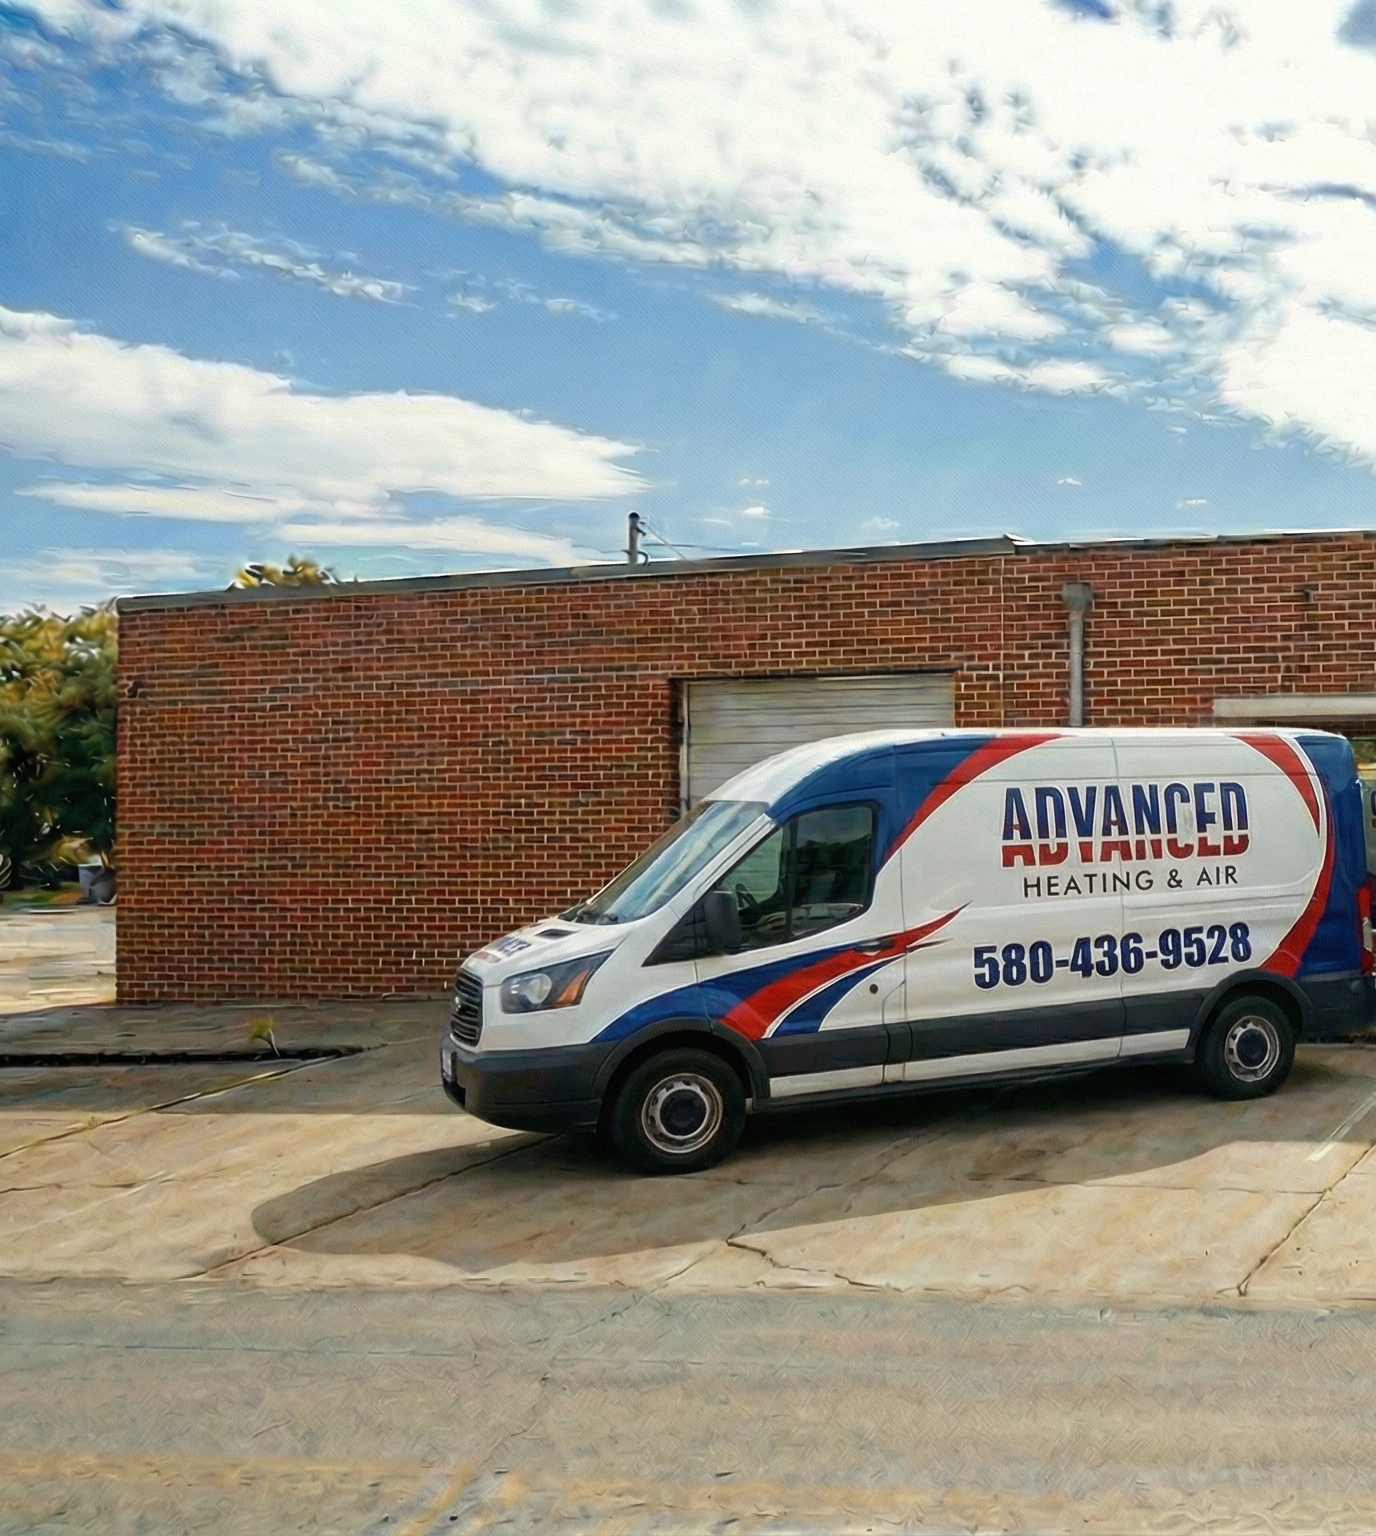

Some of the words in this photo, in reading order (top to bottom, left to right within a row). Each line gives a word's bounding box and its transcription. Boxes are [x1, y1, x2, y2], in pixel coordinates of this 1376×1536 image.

[1001, 781, 1250, 868] ADVANCED
[1023, 870, 1154, 898] HEATING
[1167, 869, 1183, 889] &
[1196, 865, 1238, 886] AIR
[973, 922, 1252, 990] 580-436-9528
